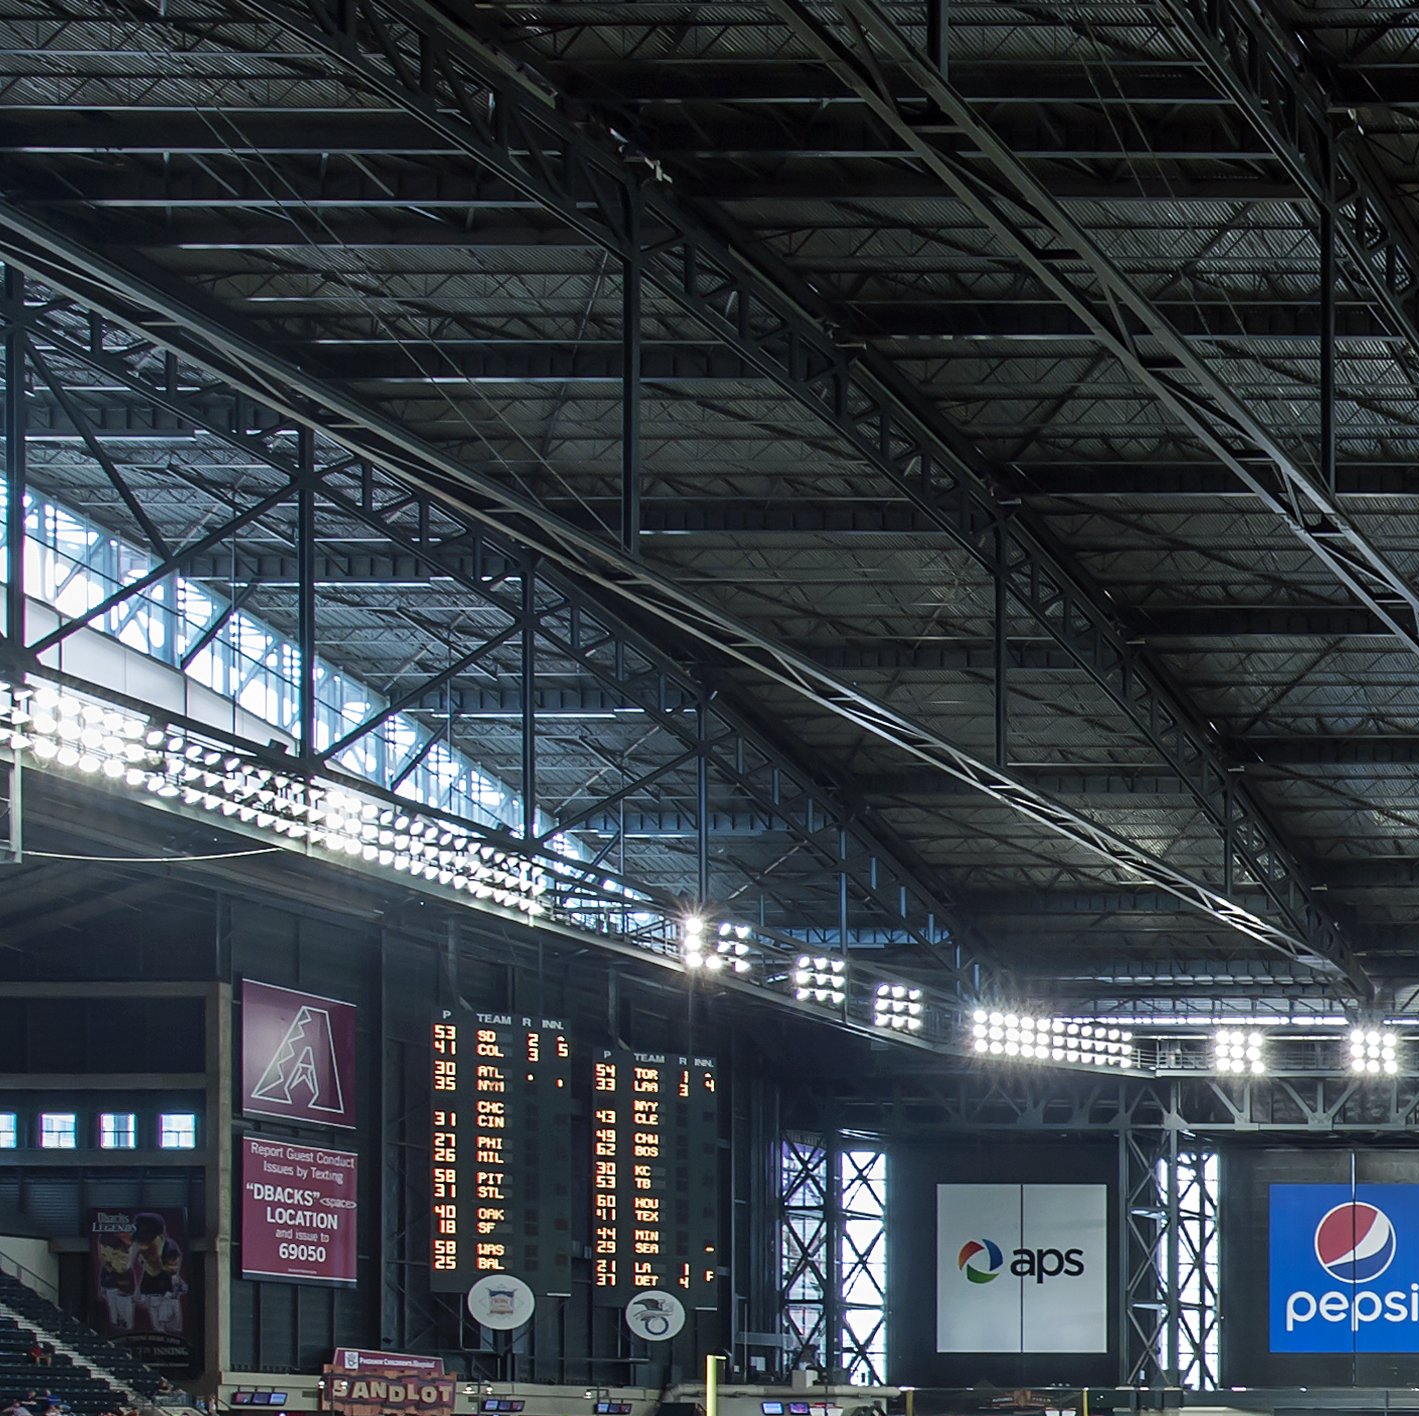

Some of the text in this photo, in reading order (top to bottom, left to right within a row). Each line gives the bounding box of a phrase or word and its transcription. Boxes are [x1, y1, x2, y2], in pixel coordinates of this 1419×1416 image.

[477, 1013, 512, 1025] TEAM
[477, 1029, 496, 1043] SD
[477, 1044, 504, 1057] COL
[477, 1065, 504, 1079] ATL
[634, 1067, 658, 1080] TOR
[477, 1101, 504, 1114] CHC
[634, 1113, 658, 1125] CLE
[477, 1136, 503, 1150] PHI
[251, 1142, 354, 1168] Report Guest Conduct
[634, 1145, 658, 1157] BOS
[264, 1161, 344, 1184] Issues by Texting
[477, 1172, 504, 1185] PIT
[267, 1207, 338, 1229] LOCATION
[477, 1222, 496, 1234] SF
[275, 1229, 329, 1242] and issue to
[279, 1243, 326, 1262] 69050
[1009, 1244, 1085, 1285] aps
[1286, 1283, 1419, 1332] pepsi
[333, 1380, 453, 1403] SANDLOT
